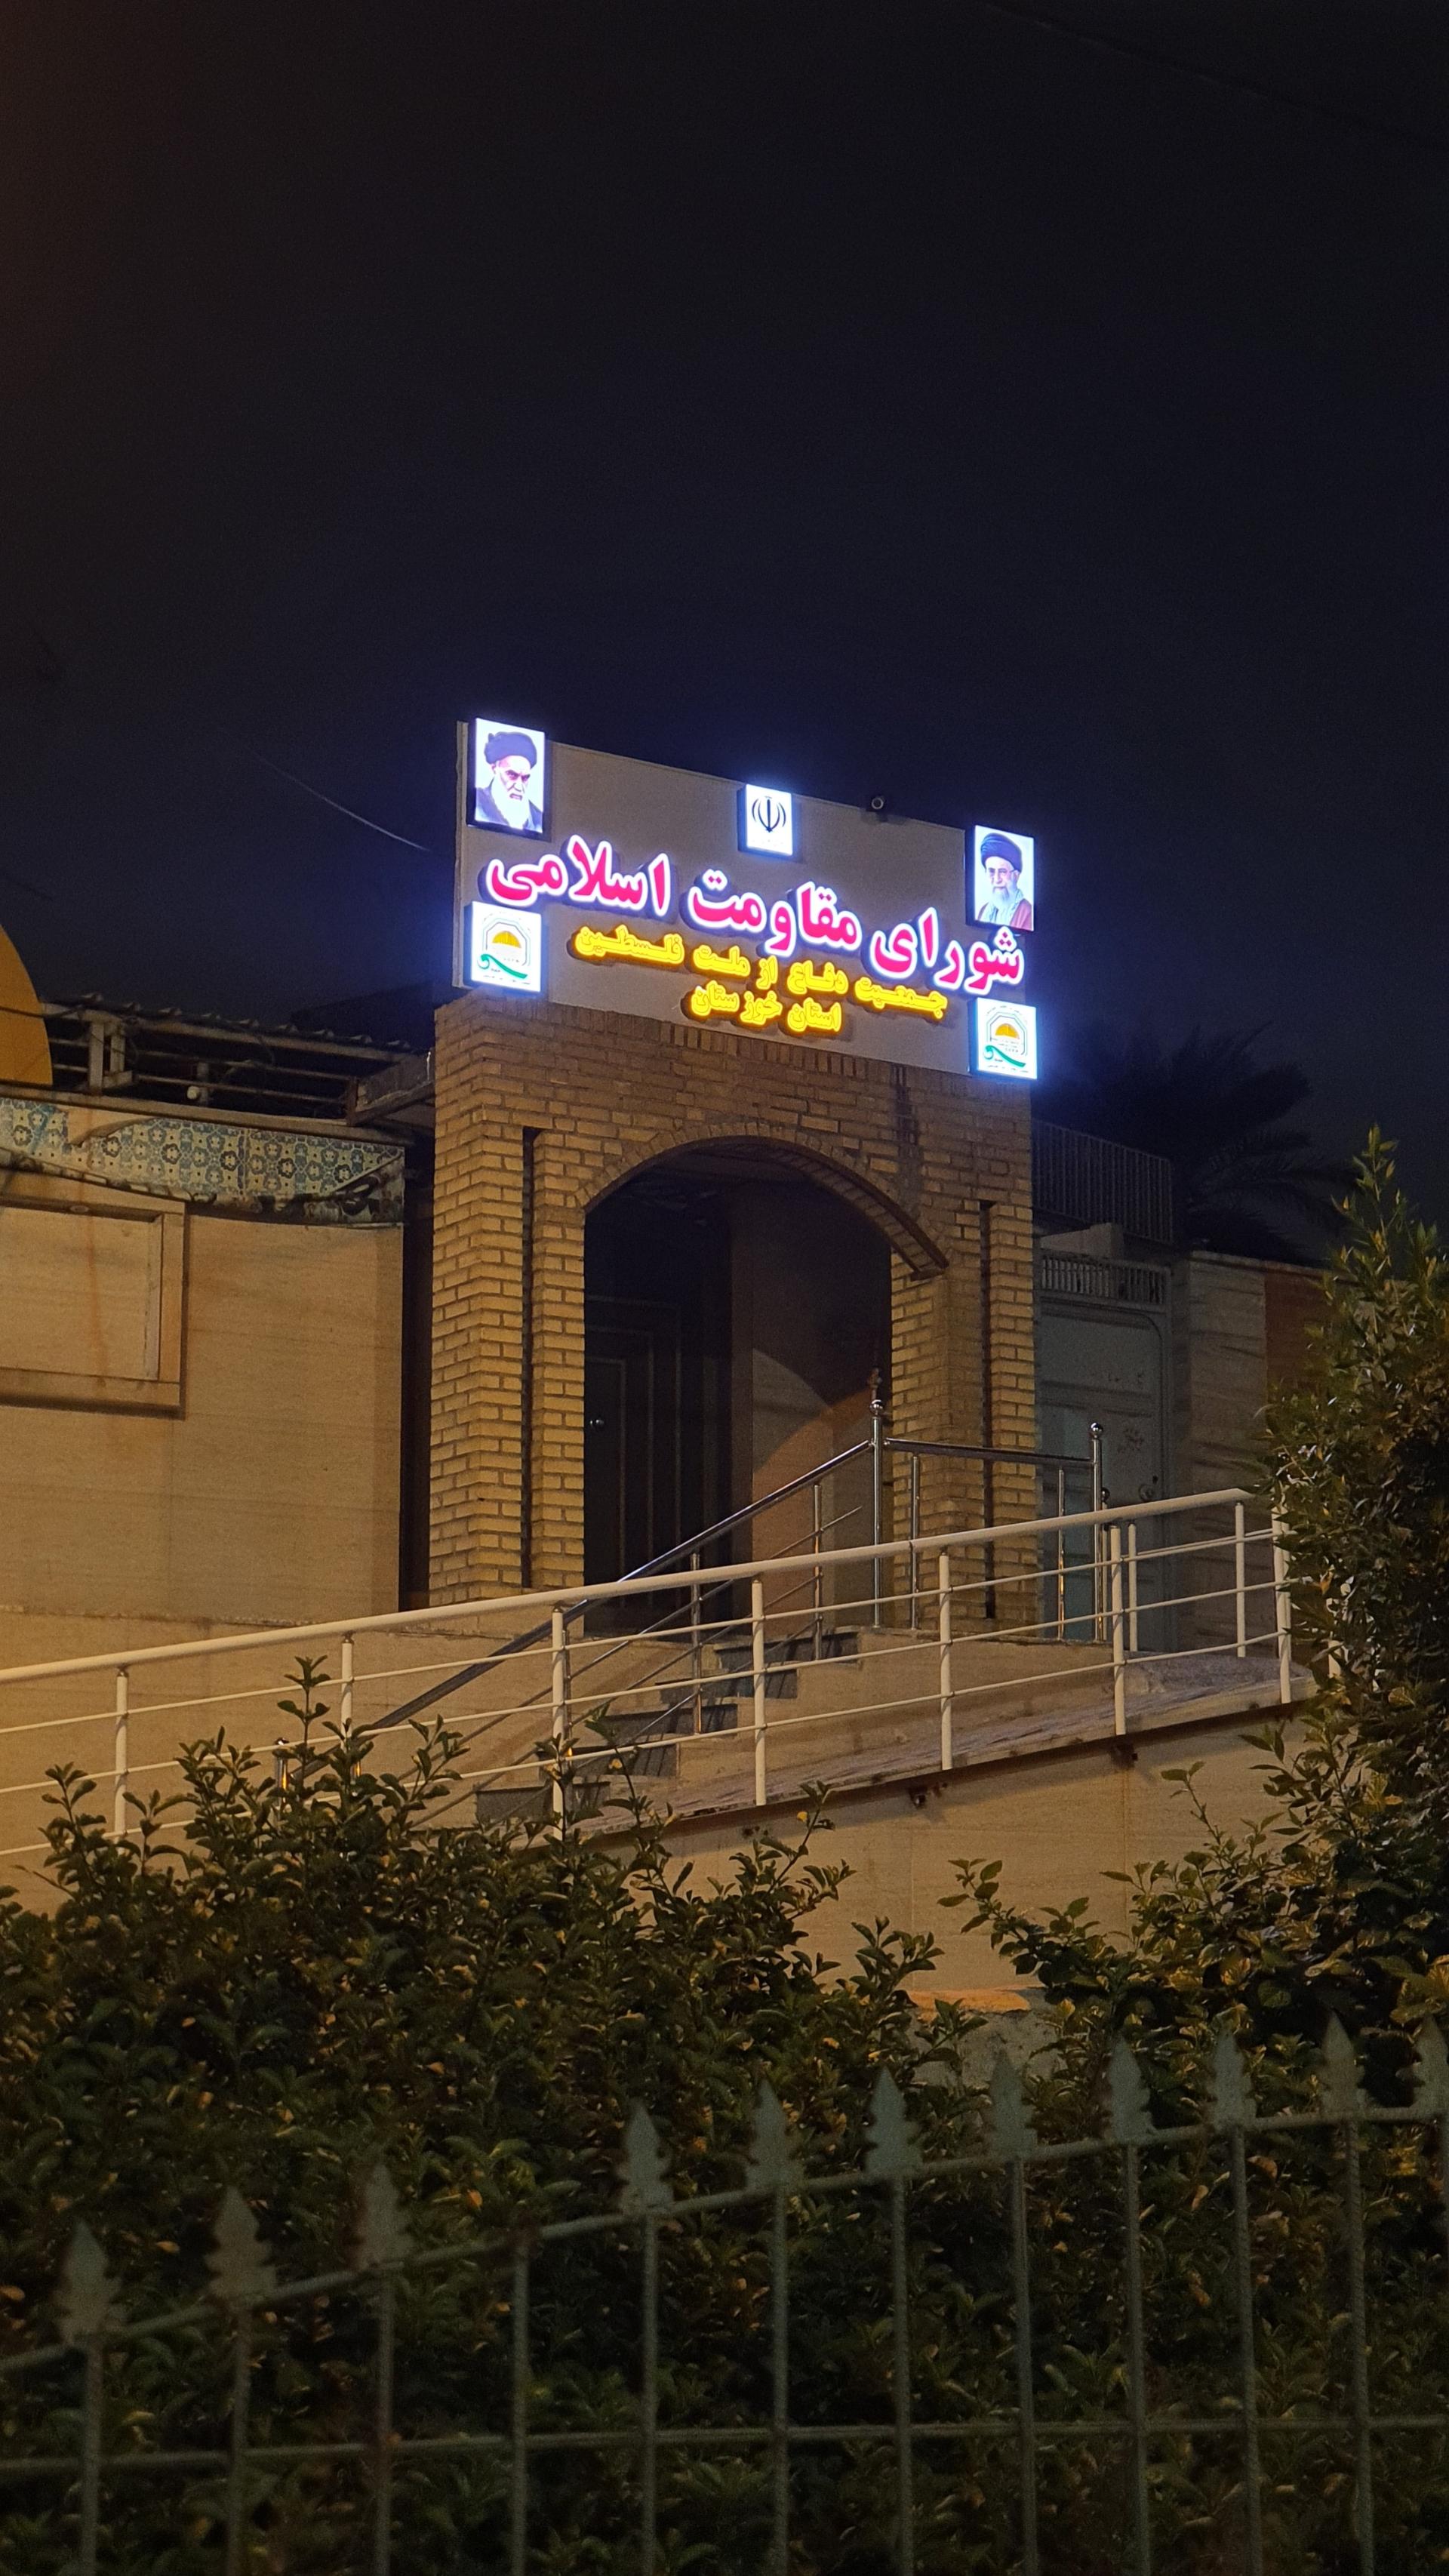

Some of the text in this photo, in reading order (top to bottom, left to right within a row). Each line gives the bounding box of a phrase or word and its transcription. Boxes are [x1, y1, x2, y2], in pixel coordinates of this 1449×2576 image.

[486, 834, 1024, 996] شورای مقاومت اسلامی
[574, 925, 685, 965] فلسطین
[692, 944, 752, 977] ملت
[755, 955, 779, 991] از
[786, 959, 850, 996] دفاع
[786, 996, 842, 1032] استان
[854, 977, 948, 1020] جمعیت
